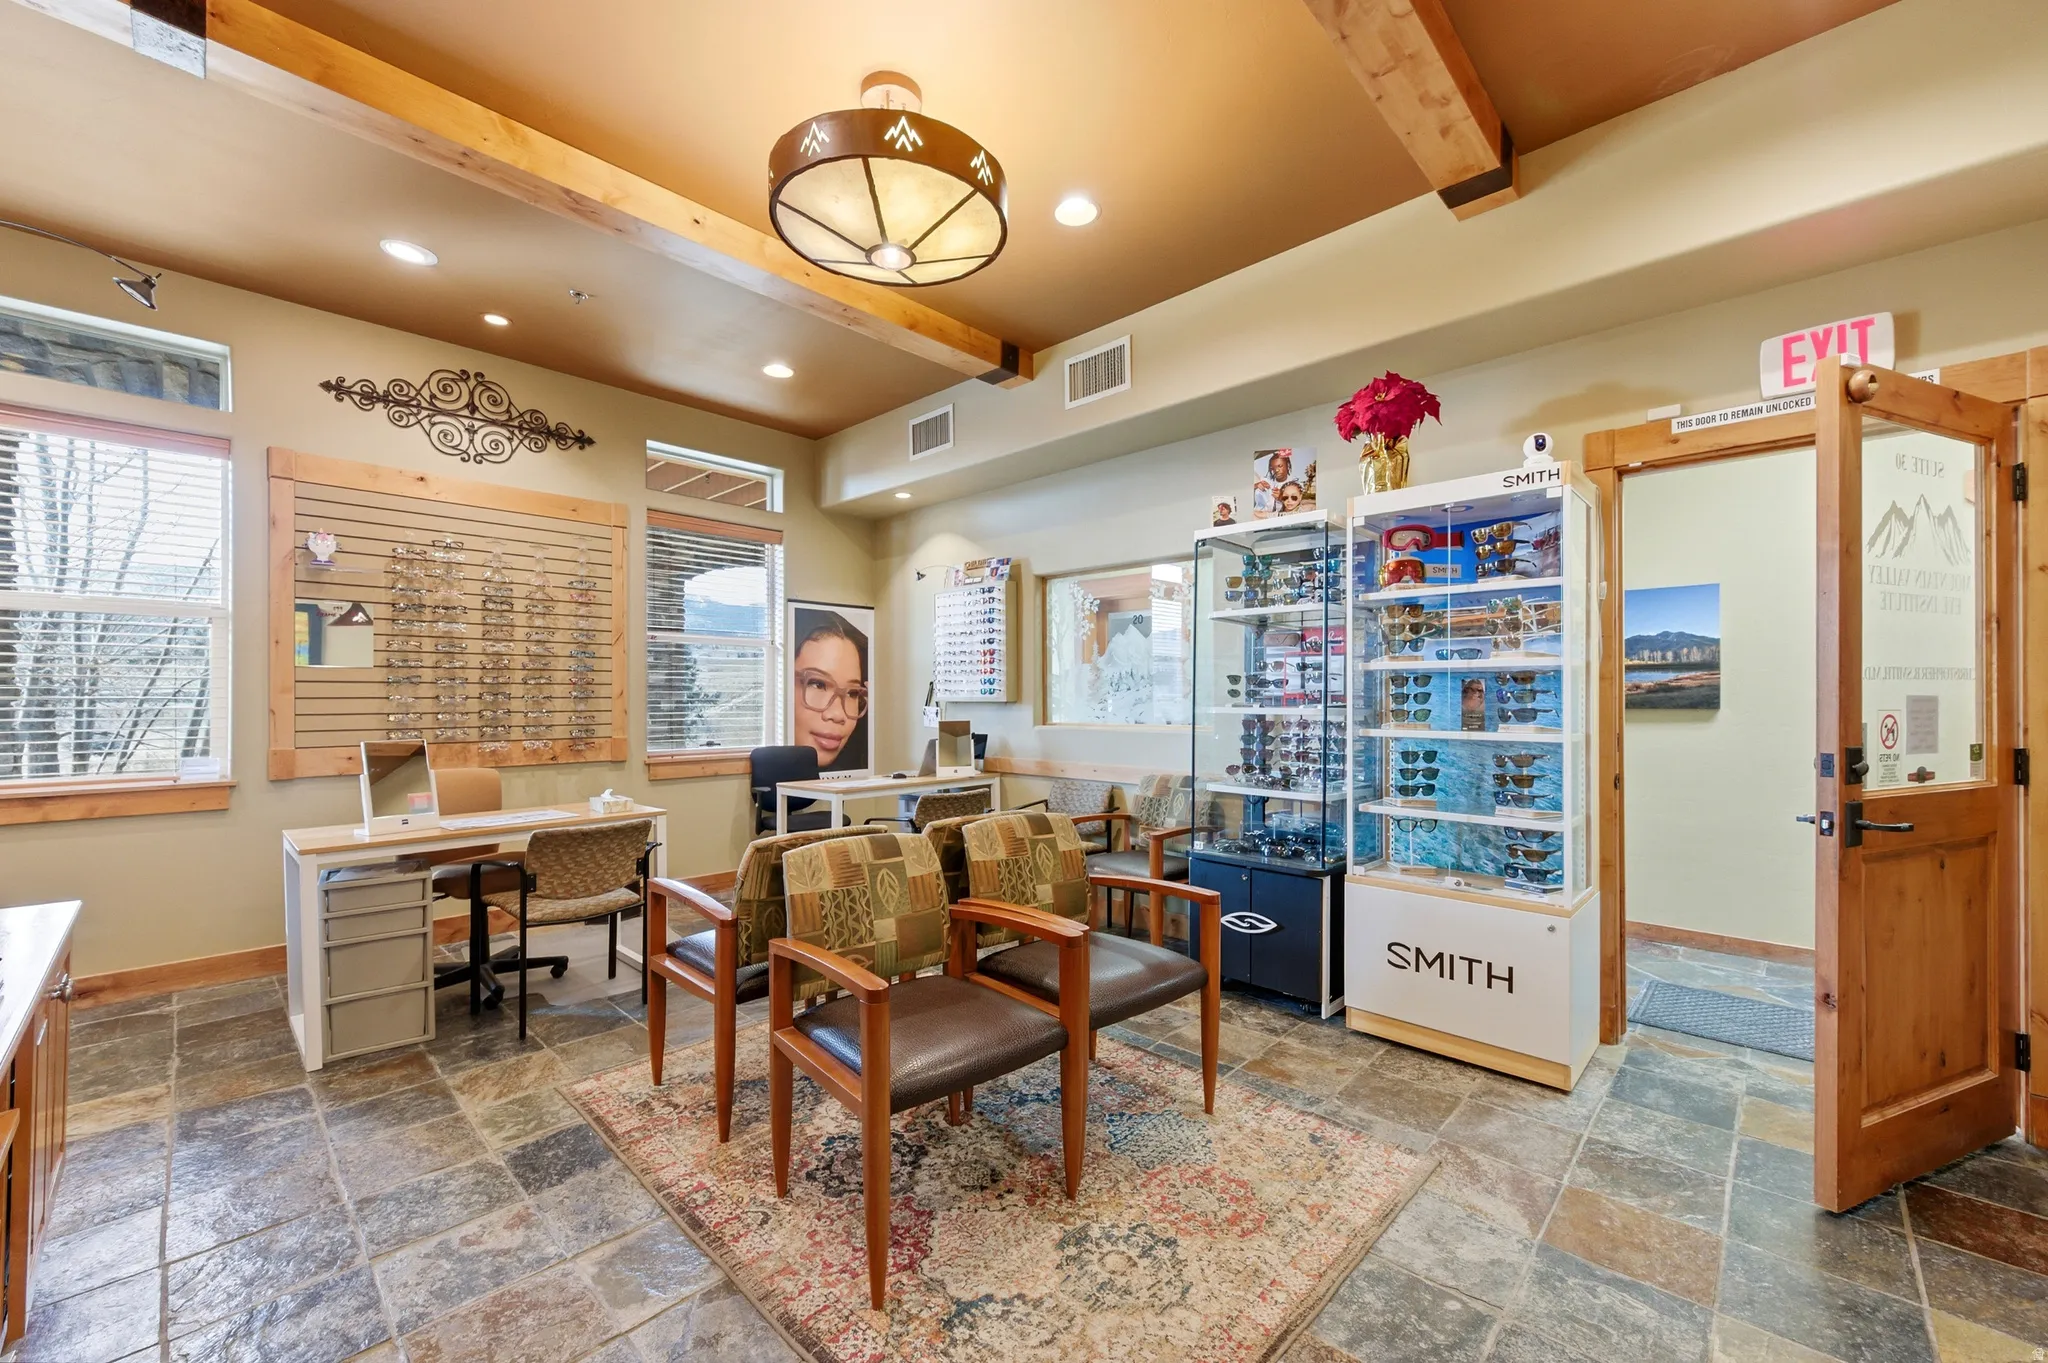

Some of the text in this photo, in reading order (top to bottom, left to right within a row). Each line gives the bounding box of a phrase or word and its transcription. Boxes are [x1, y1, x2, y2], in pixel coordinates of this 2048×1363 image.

[1782, 317, 1876, 388] EXIT
[1676, 420, 1693, 430] THIS
[1695, 414, 1717, 426] DOOR
[1719, 412, 1729, 422] TO
[1730, 406, 1763, 420] REMAIN
[1765, 396, 1812, 414] UNLOCKED
[1502, 467, 1560, 488] SMITH
[1432, 565, 1458, 574] SMIH
[1132, 614, 1144, 625] 20
[1387, 941, 1514, 995] SMITH
